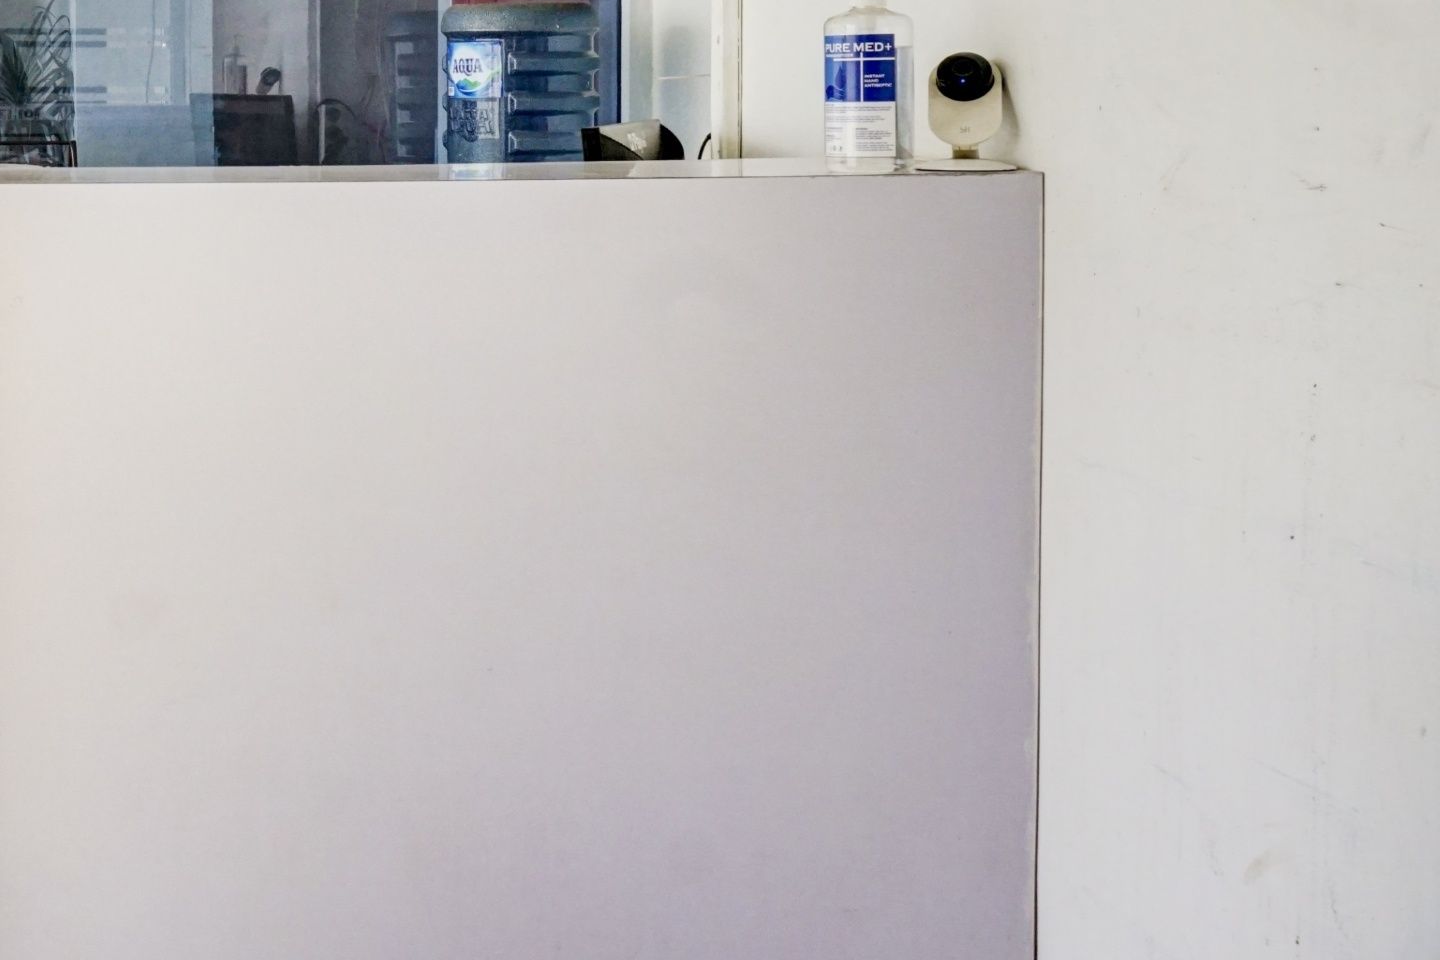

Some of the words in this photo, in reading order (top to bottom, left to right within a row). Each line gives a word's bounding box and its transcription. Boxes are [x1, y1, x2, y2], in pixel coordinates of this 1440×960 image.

[825, 42, 851, 53] PURE
[853, 42, 892, 52] MED+
[452, 57, 483, 76] AQUA
